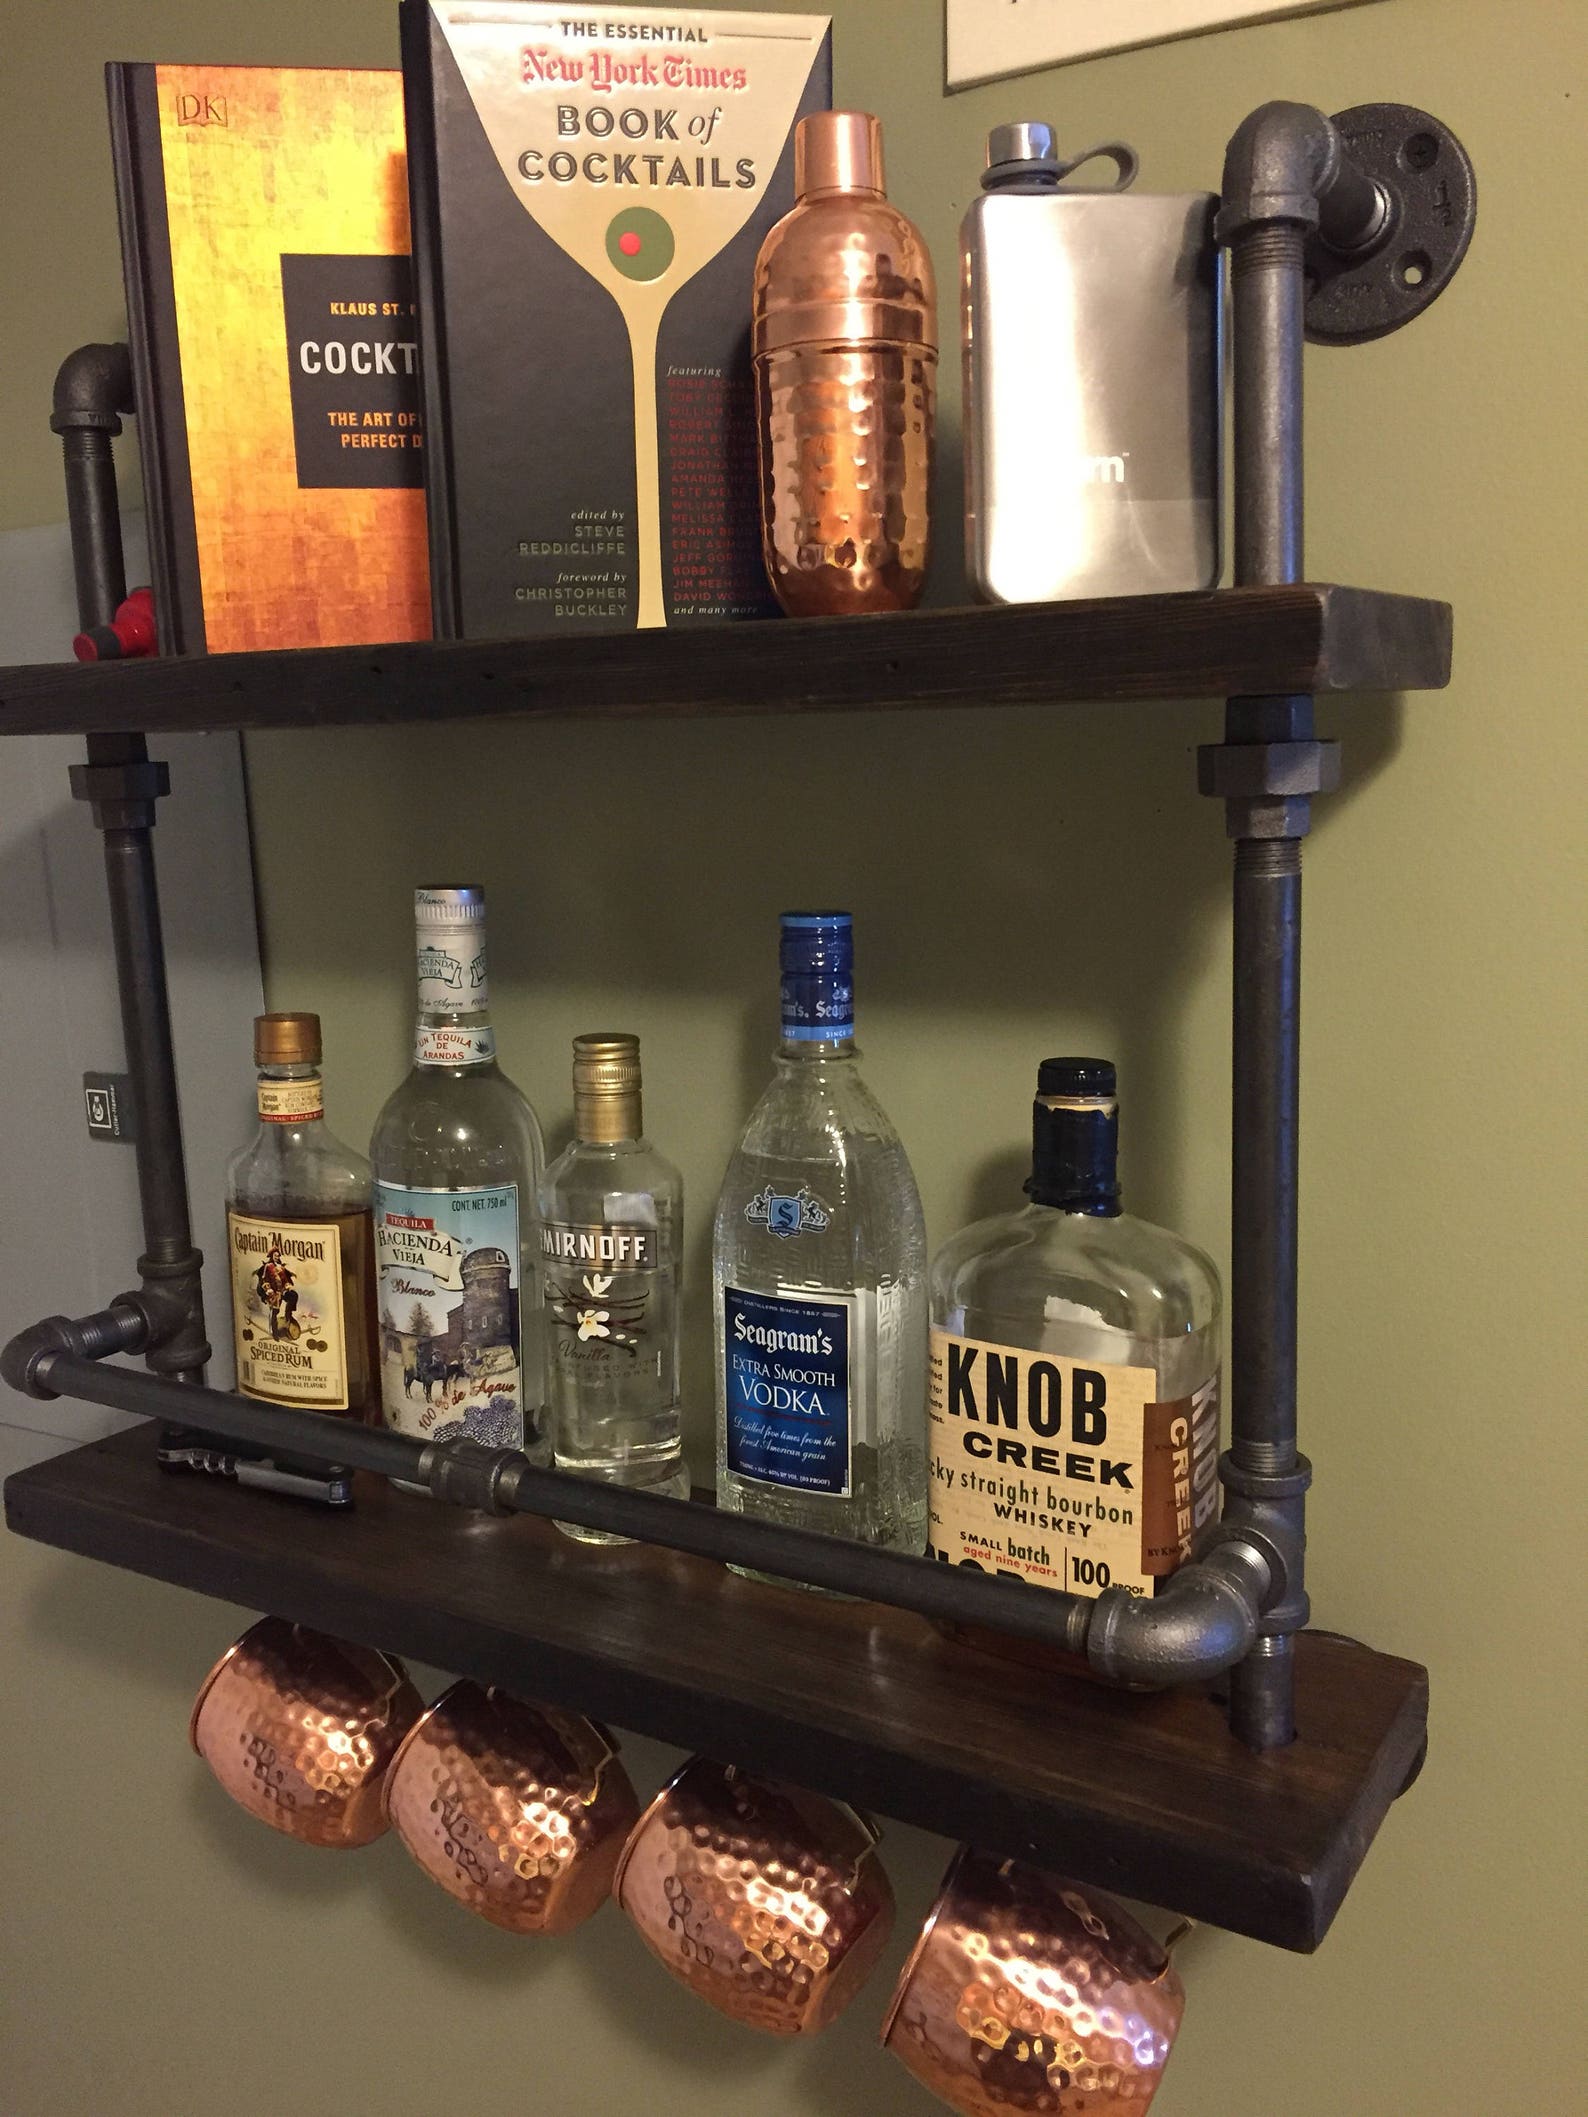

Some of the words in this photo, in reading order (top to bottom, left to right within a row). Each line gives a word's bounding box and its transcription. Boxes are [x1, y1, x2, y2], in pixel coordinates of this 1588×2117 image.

[561, 21, 598, 38] THE
[605, 24, 708, 43] ESSENTIAL
[522, 48, 583, 84] New
[589, 53, 659, 92] York
[663, 55, 747, 91] Times
[181, 93, 222, 120] DK
[557, 105, 680, 141] BOOK
[688, 106, 722, 145] of
[518, 150, 756, 189] COCKTAILS
[330, 302, 377, 316] KLAUS
[382, 302, 404, 315] ST.
[666, 365, 722, 377] featuring
[328, 412, 358, 427] THE
[363, 412, 393, 427] ART
[398, 412, 417, 427] OF
[341, 433, 406, 448] PERFECT
[671, 474, 725, 484] AMANDA
[571, 509, 607, 520] edited
[611, 510, 625, 522] by
[574, 525, 625, 537] STEVE
[518, 543, 626, 555] REDDICLIFFE
[556, 571, 609, 584] foreword
[614, 572, 627, 584] by
[673, 579, 694, 589] JIM
[515, 587, 627, 600] CHRISTOPHER
[673, 592, 711, 602] DAVID
[555, 605, 627, 616] BUCKLEY
[674, 604, 695, 615] and
[699, 606, 727, 617] many
[418, 1037, 429, 1048] UN
[431, 1033, 472, 1048] TEQUILA
[436, 1042, 448, 1050] DE
[423, 1051, 465, 1060] ARANDAS
[452, 1199, 469, 1212] CONT.
[487, 1198, 498, 1209] 750
[389, 1216, 427, 1229] TEQUILA
[234, 1226, 268, 1255] Captain
[268, 1231, 325, 1262] Morgan
[378, 1230, 453, 1257] HACIENDA
[393, 1249, 425, 1266] VIEJA
[391, 1278, 436, 1298] Blanco
[734, 1312, 833, 1356] Seagram's
[250, 1346, 285, 1362] SPICED
[286, 1353, 314, 1370] RUM
[258, 1341, 301, 1355] ORIGINAL
[559, 1340, 612, 1362] Vanilla
[732, 1353, 770, 1378] EXTRA
[774, 1363, 836, 1387] SMOOTH
[418, 1407, 437, 1431] 100
[451, 1389, 466, 1406] de
[470, 1379, 516, 1398] Agave
[738, 1375, 826, 1416] VODKA
[948, 1342, 1107, 1446] KNOB
[733, 1415, 765, 1435] Distilled
[763, 1425, 779, 1439] five
[780, 1430, 800, 1442] times
[800, 1432, 822, 1447] from
[824, 1435, 837, 1447] the
[760, 1439, 801, 1457] American
[802, 1452, 826, 1463] grain
[962, 1431, 1135, 1489] CREEK
[961, 1471, 1039, 1505] straight
[1047, 1486, 1133, 1525] bourbon
[1170, 1416, 1192, 1564] CREEK
[993, 1502, 1091, 1538] WHISKEY
[960, 1531, 1002, 1551] SMALL
[1008, 1537, 1050, 1566] batch
[963, 1546, 991, 1560] aged
[996, 1553, 1020, 1568] nine
[1024, 1562, 1058, 1578] years
[1072, 1556, 1110, 1588] 100
